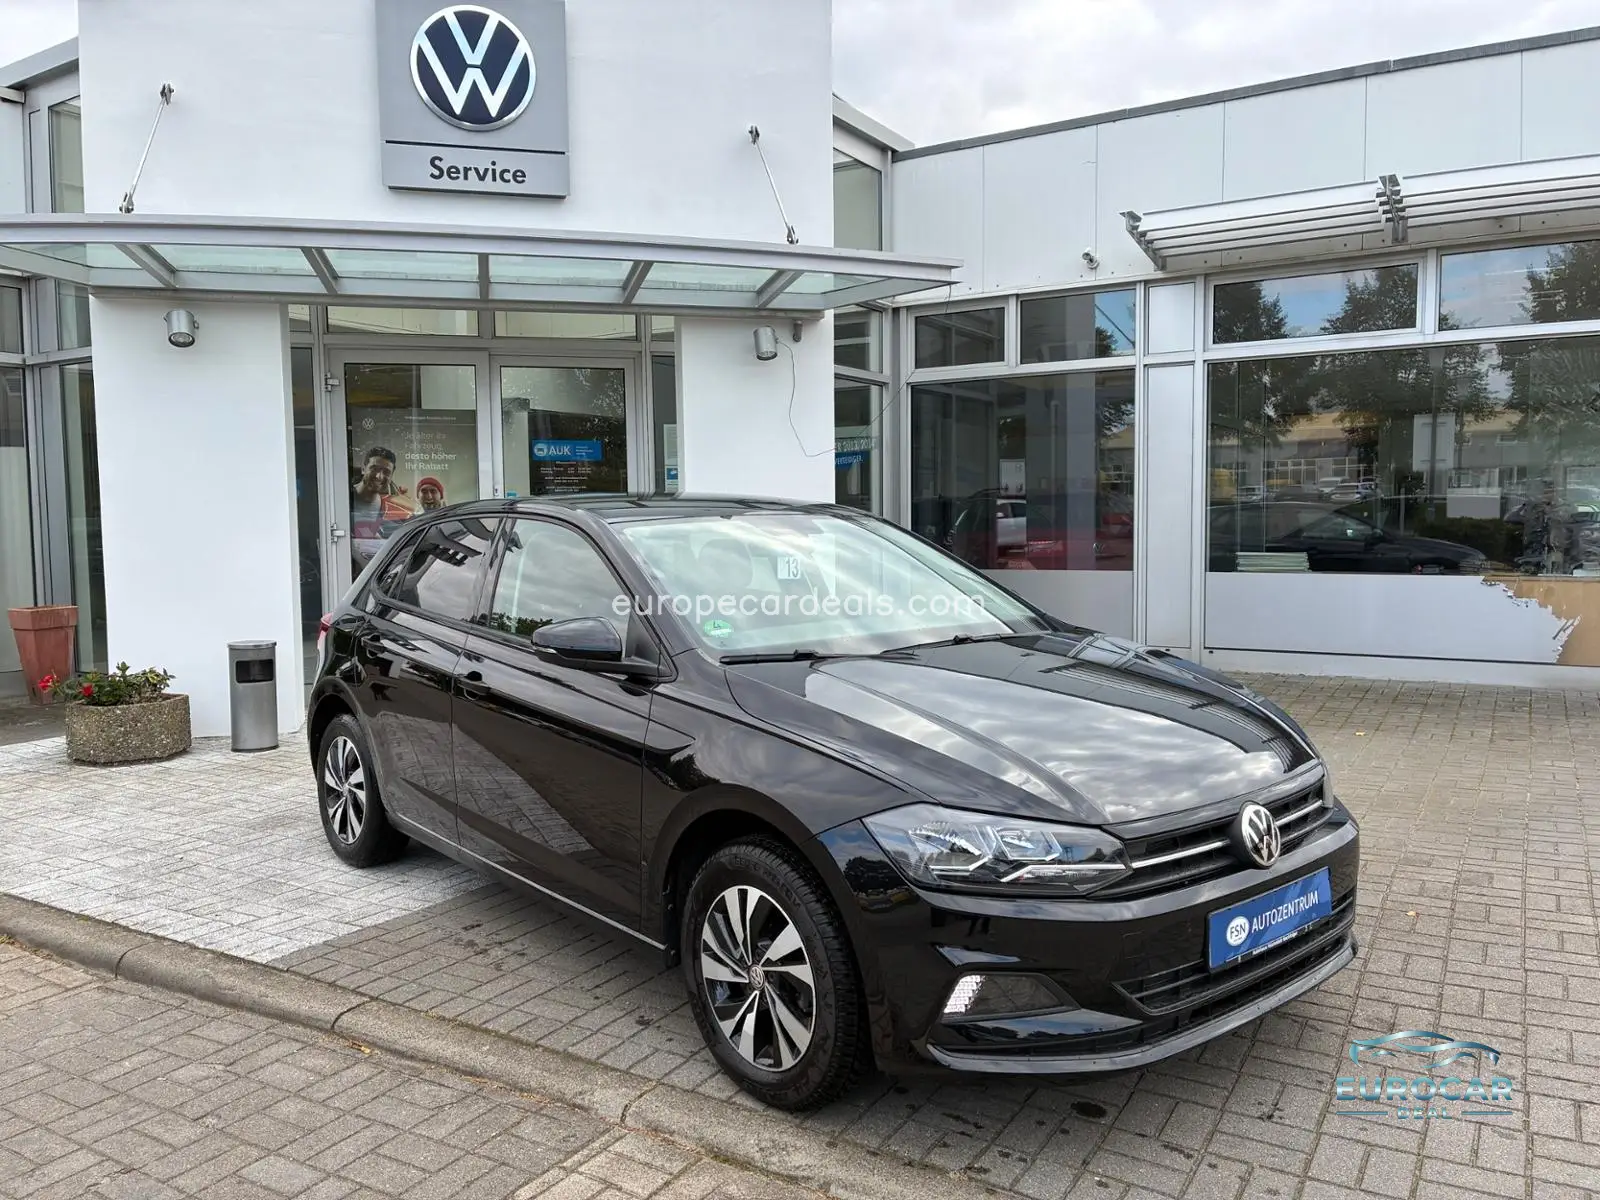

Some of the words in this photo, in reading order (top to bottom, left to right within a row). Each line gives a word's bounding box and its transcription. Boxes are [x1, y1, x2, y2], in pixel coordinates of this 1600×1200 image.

[429, 156, 527, 184] Service
[405, 452, 430, 460] desto
[549, 446, 572, 456] AUK
[419, 462, 448, 470] Rabatt
[786, 558, 799, 577] 13
[1229, 922, 1246, 940] FSN
[1251, 890, 1319, 934] AUTOZENTRUM
